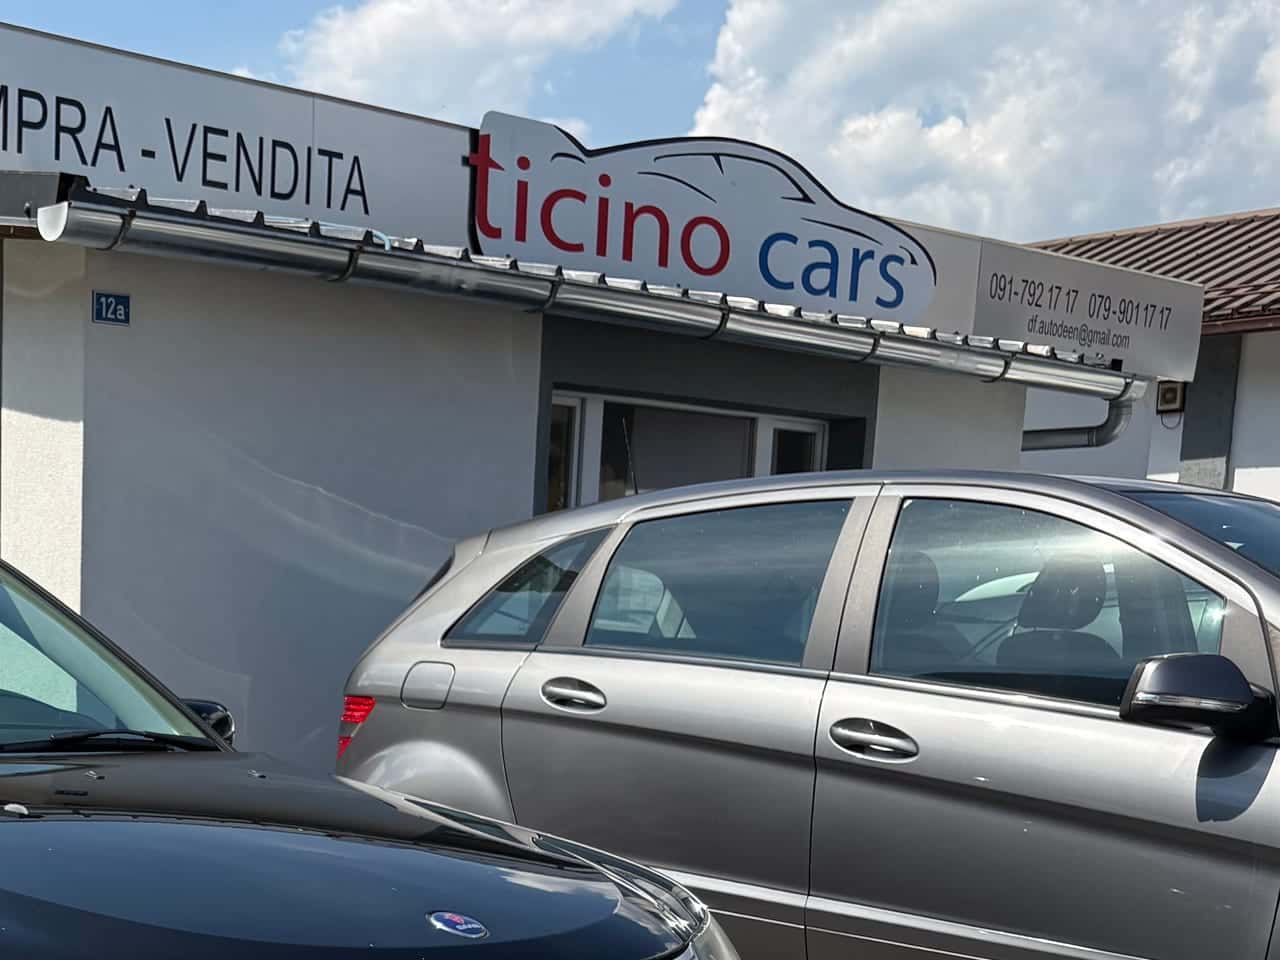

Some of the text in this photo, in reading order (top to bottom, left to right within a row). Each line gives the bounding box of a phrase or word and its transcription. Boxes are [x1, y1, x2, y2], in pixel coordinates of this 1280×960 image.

[165, 117, 370, 215] VENDITA
[467, 133, 907, 310] ticino cars
[100, 296, 126, 320] 12a
[989, 272, 1172, 332] 091-792 17 17 079-901 17 17
